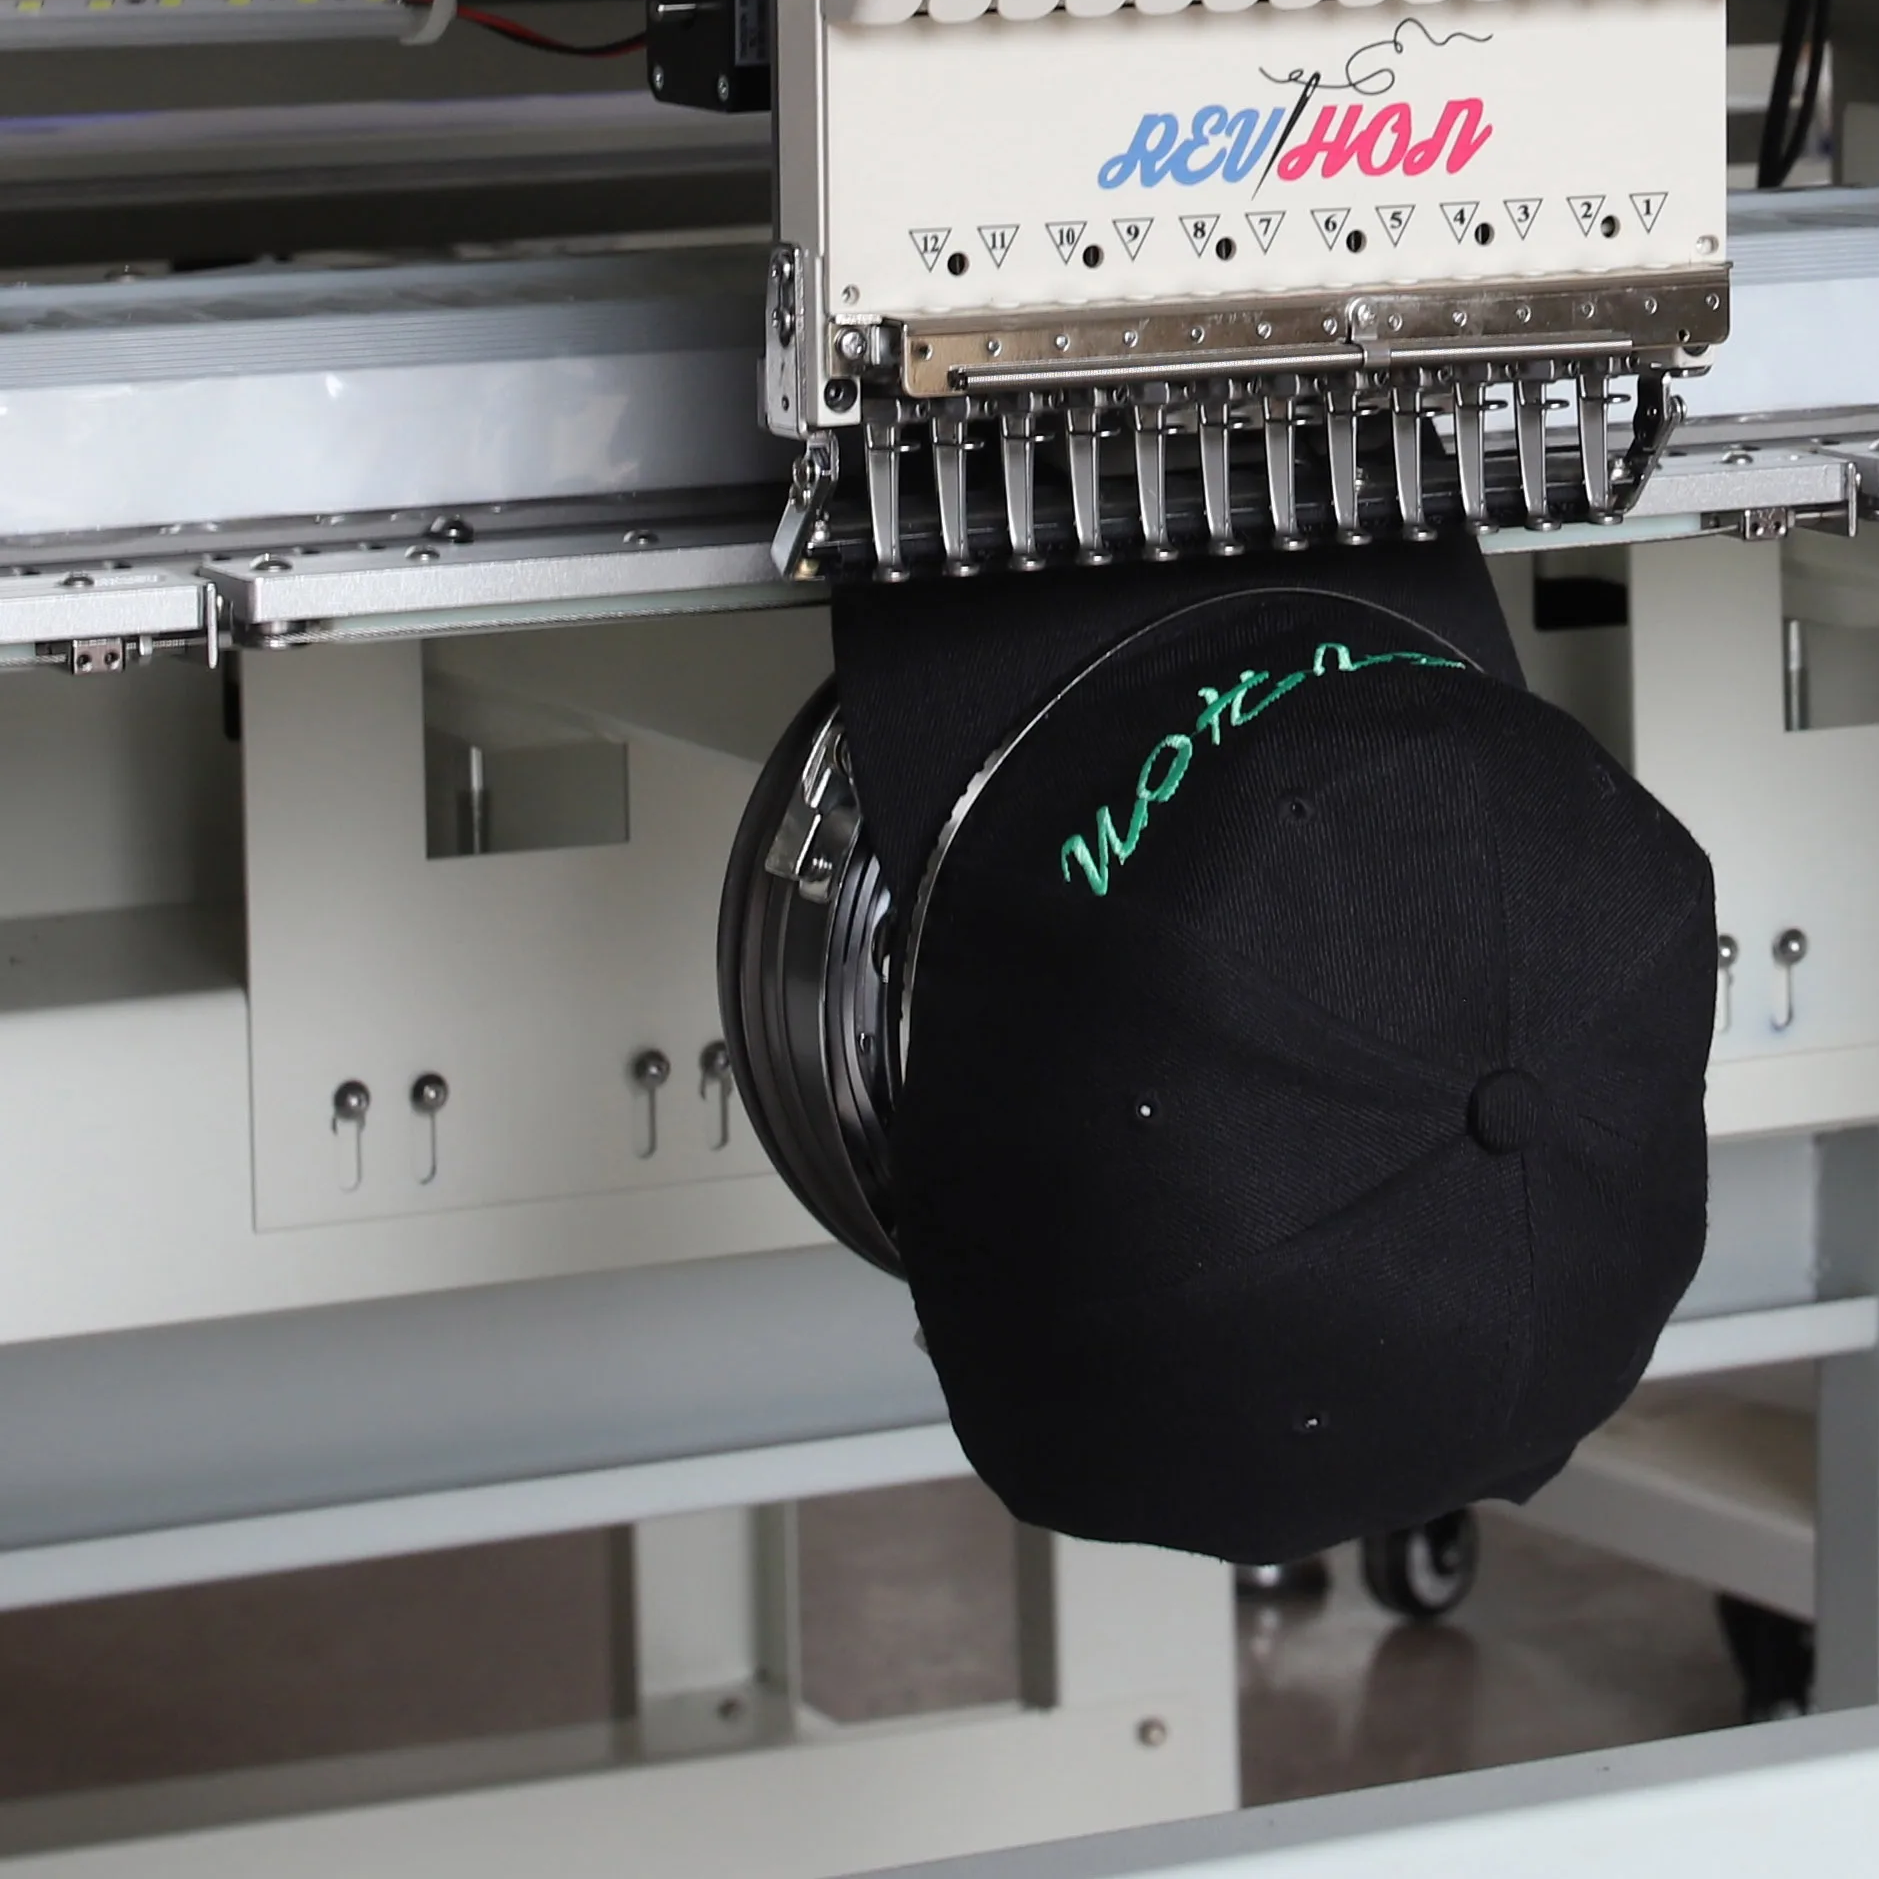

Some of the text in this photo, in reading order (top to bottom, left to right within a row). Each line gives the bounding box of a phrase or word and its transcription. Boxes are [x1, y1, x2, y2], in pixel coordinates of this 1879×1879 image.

[921, 200, 1652, 253] 12 11 10 9 8 7 6 5 4 3 2 1
